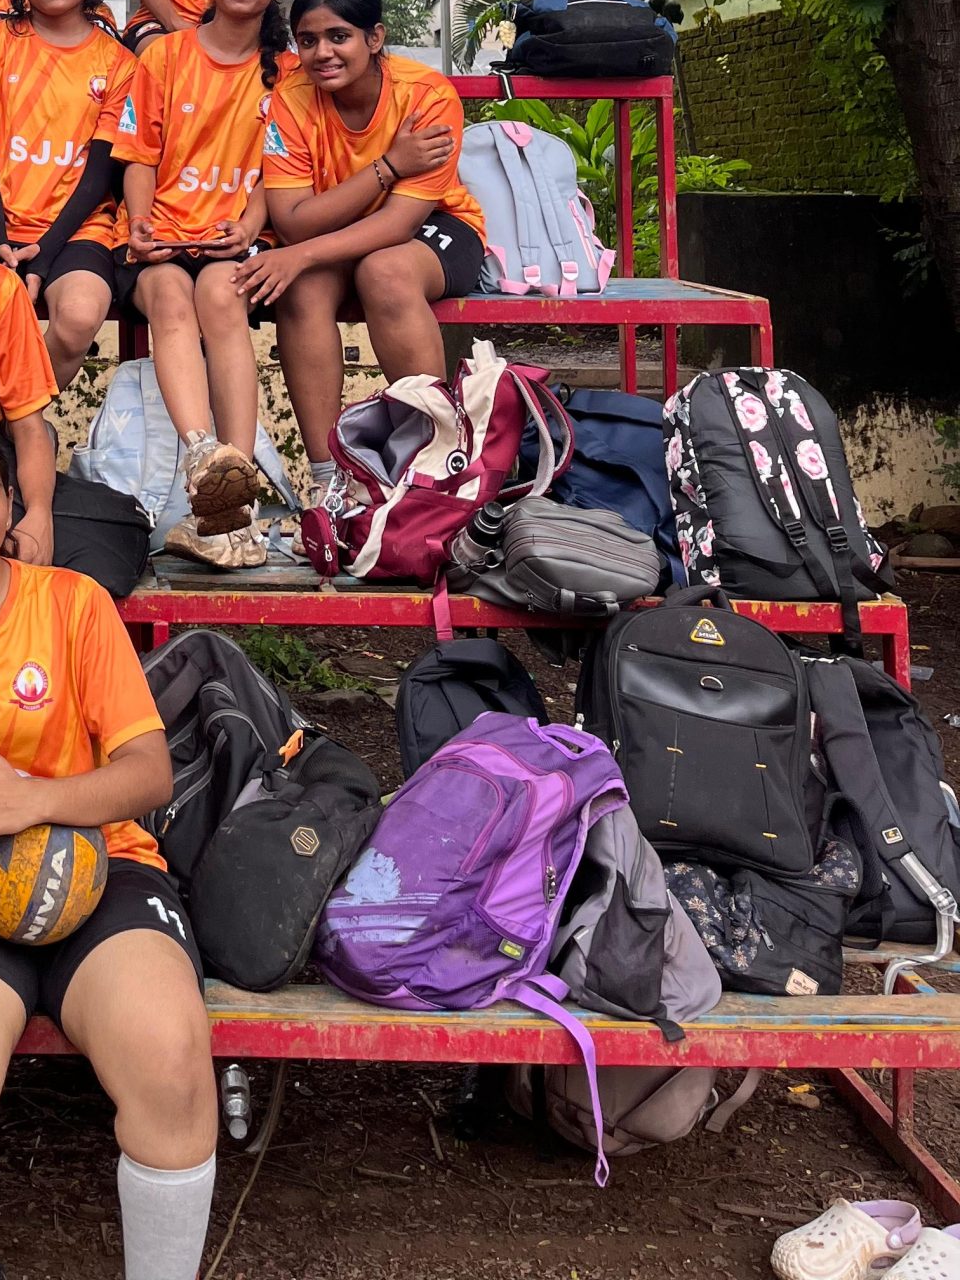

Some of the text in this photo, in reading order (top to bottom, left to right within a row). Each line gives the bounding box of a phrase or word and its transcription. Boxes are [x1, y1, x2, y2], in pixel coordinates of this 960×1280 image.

[421, 224, 453, 251] 11
[22, 847, 67, 942] NIVIA
[147, 896, 187, 941] 11
